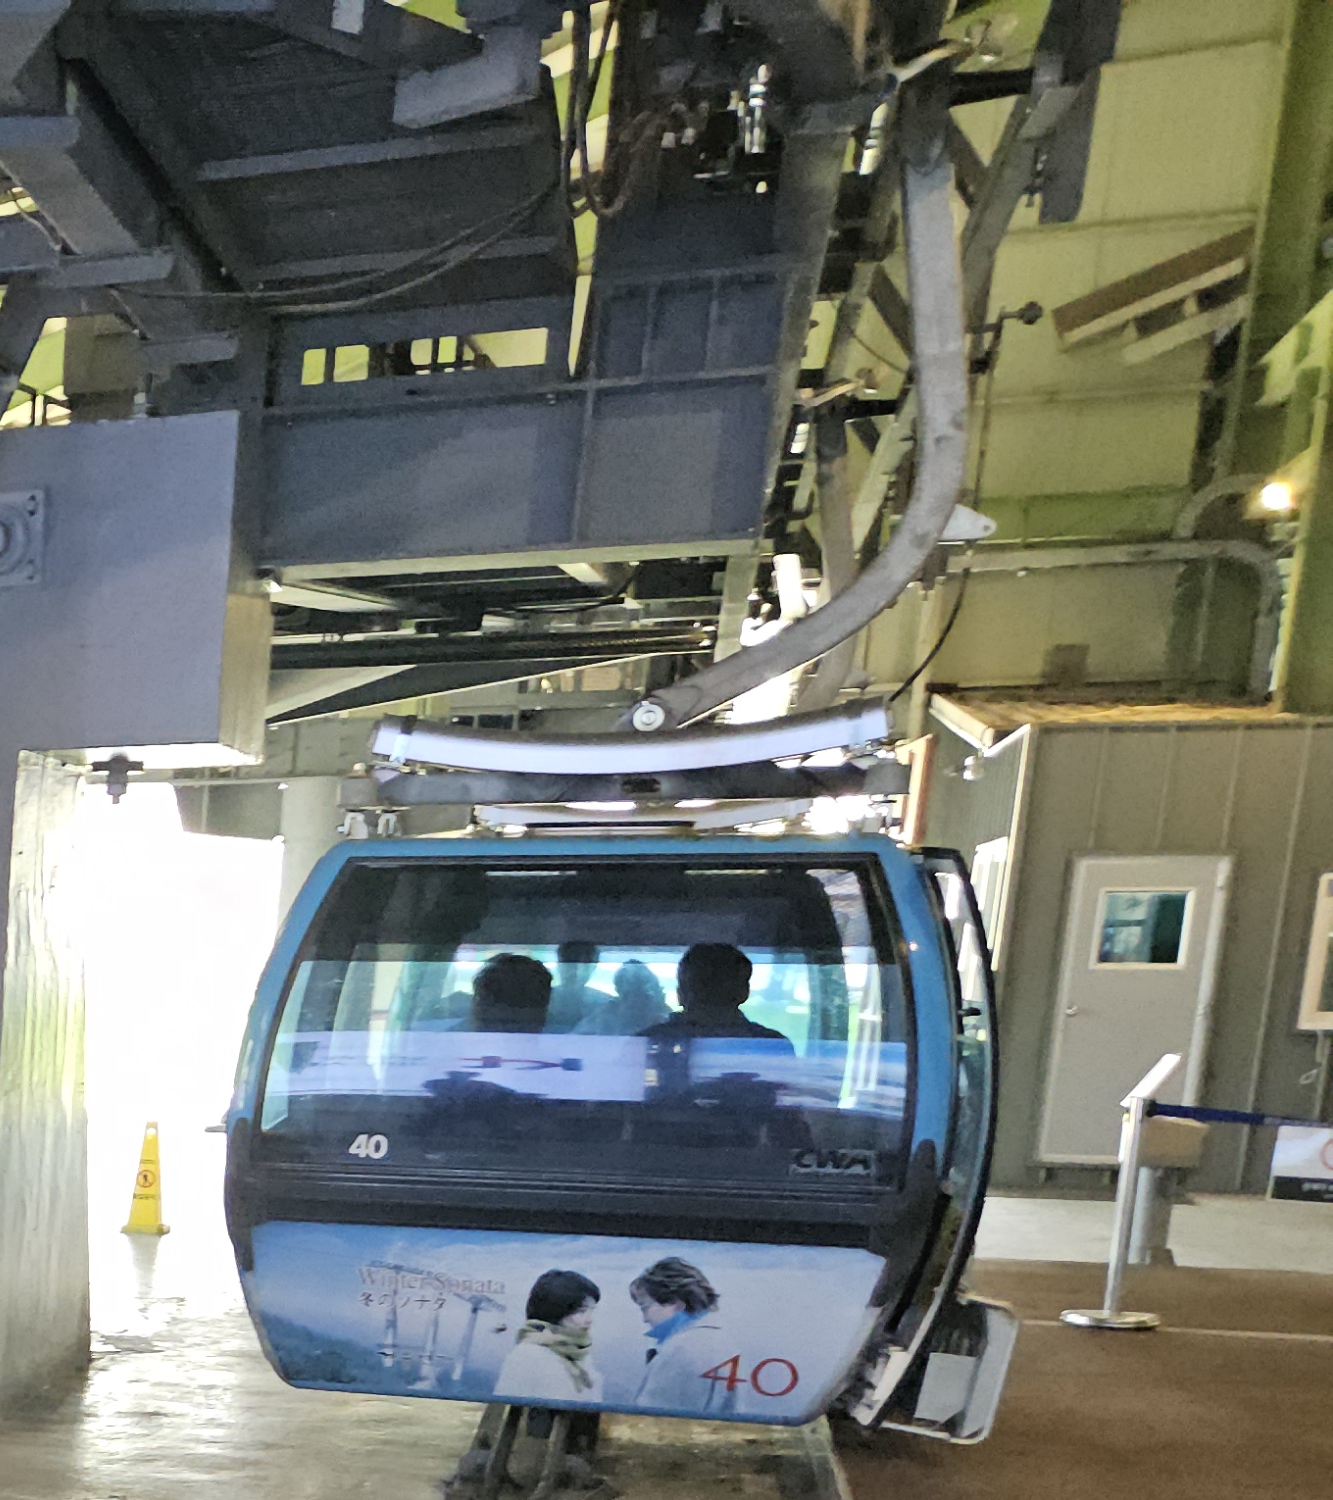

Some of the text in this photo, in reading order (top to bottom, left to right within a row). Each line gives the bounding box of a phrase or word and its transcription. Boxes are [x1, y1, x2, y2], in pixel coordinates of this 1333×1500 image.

[348, 1133, 389, 1160] 40
[433, 1271, 507, 1295] Sonata
[698, 1353, 801, 1397] 40
